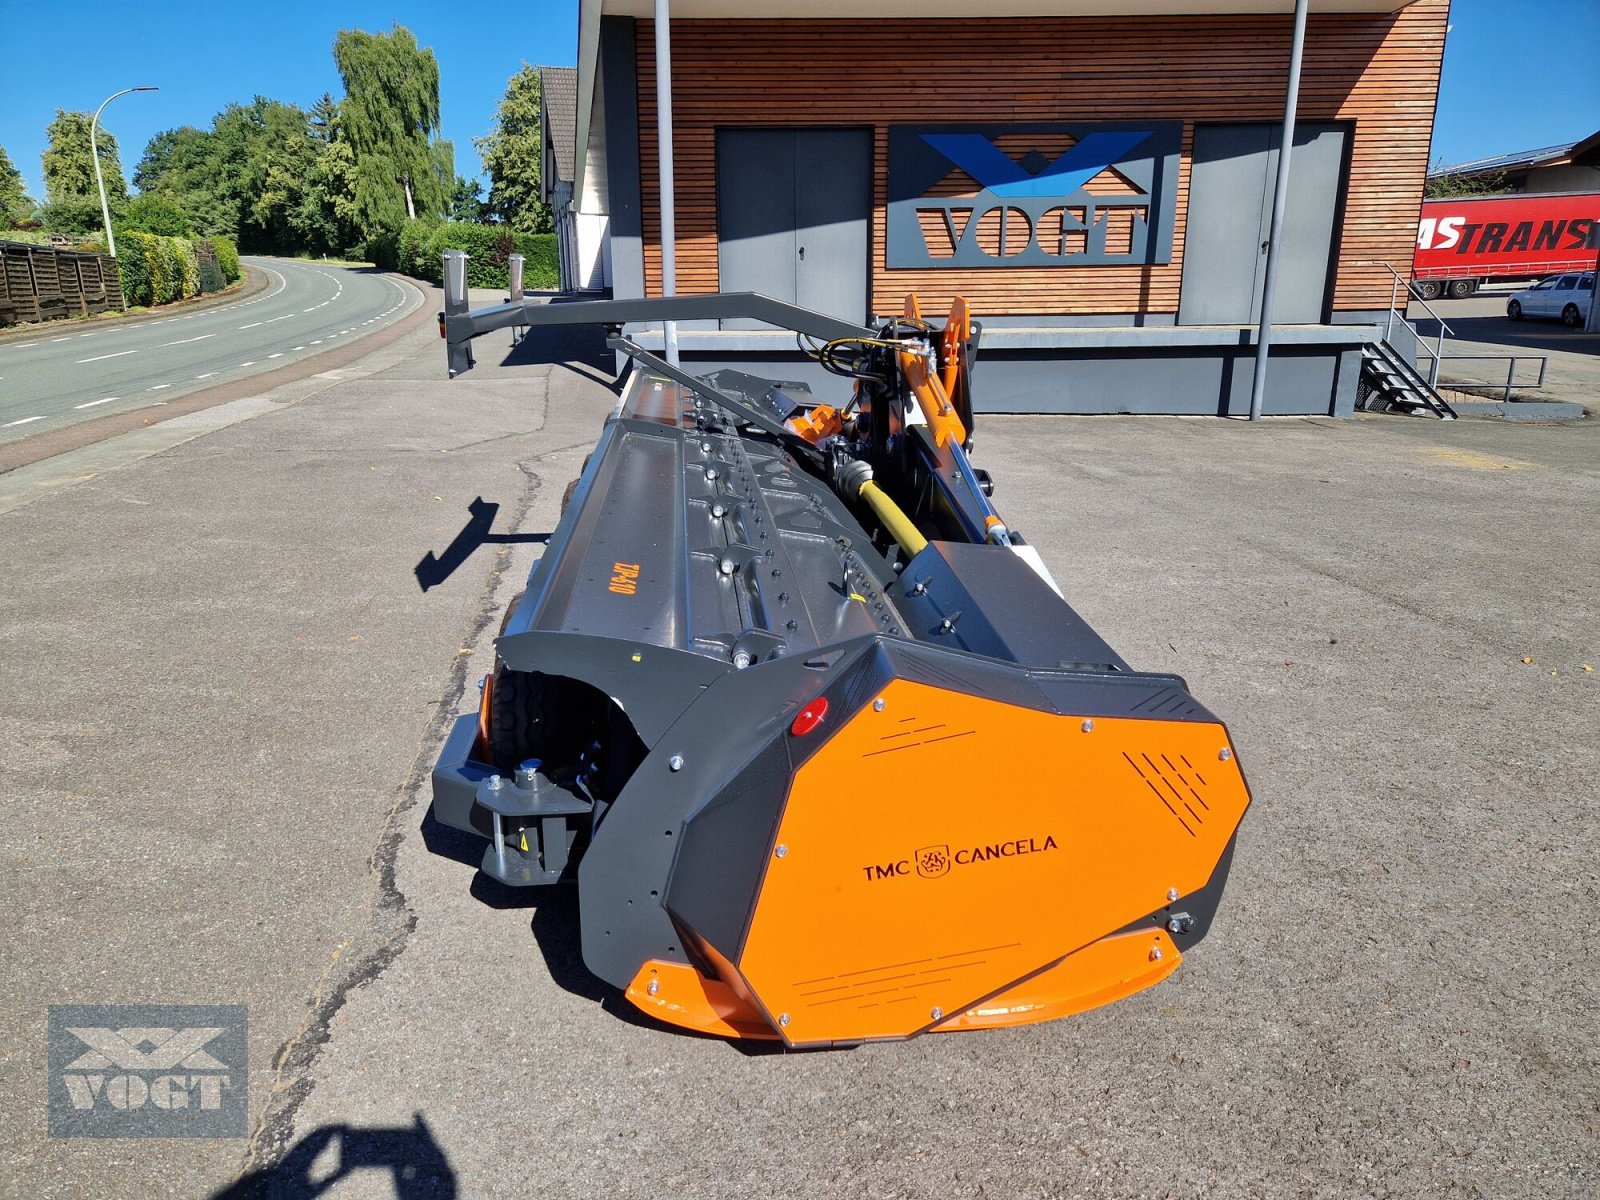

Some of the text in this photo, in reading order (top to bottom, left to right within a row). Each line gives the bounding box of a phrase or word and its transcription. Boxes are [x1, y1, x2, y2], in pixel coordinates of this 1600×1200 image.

[915, 205, 1149, 258] VOGT
[863, 835, 1058, 882] TMC CANCELA
